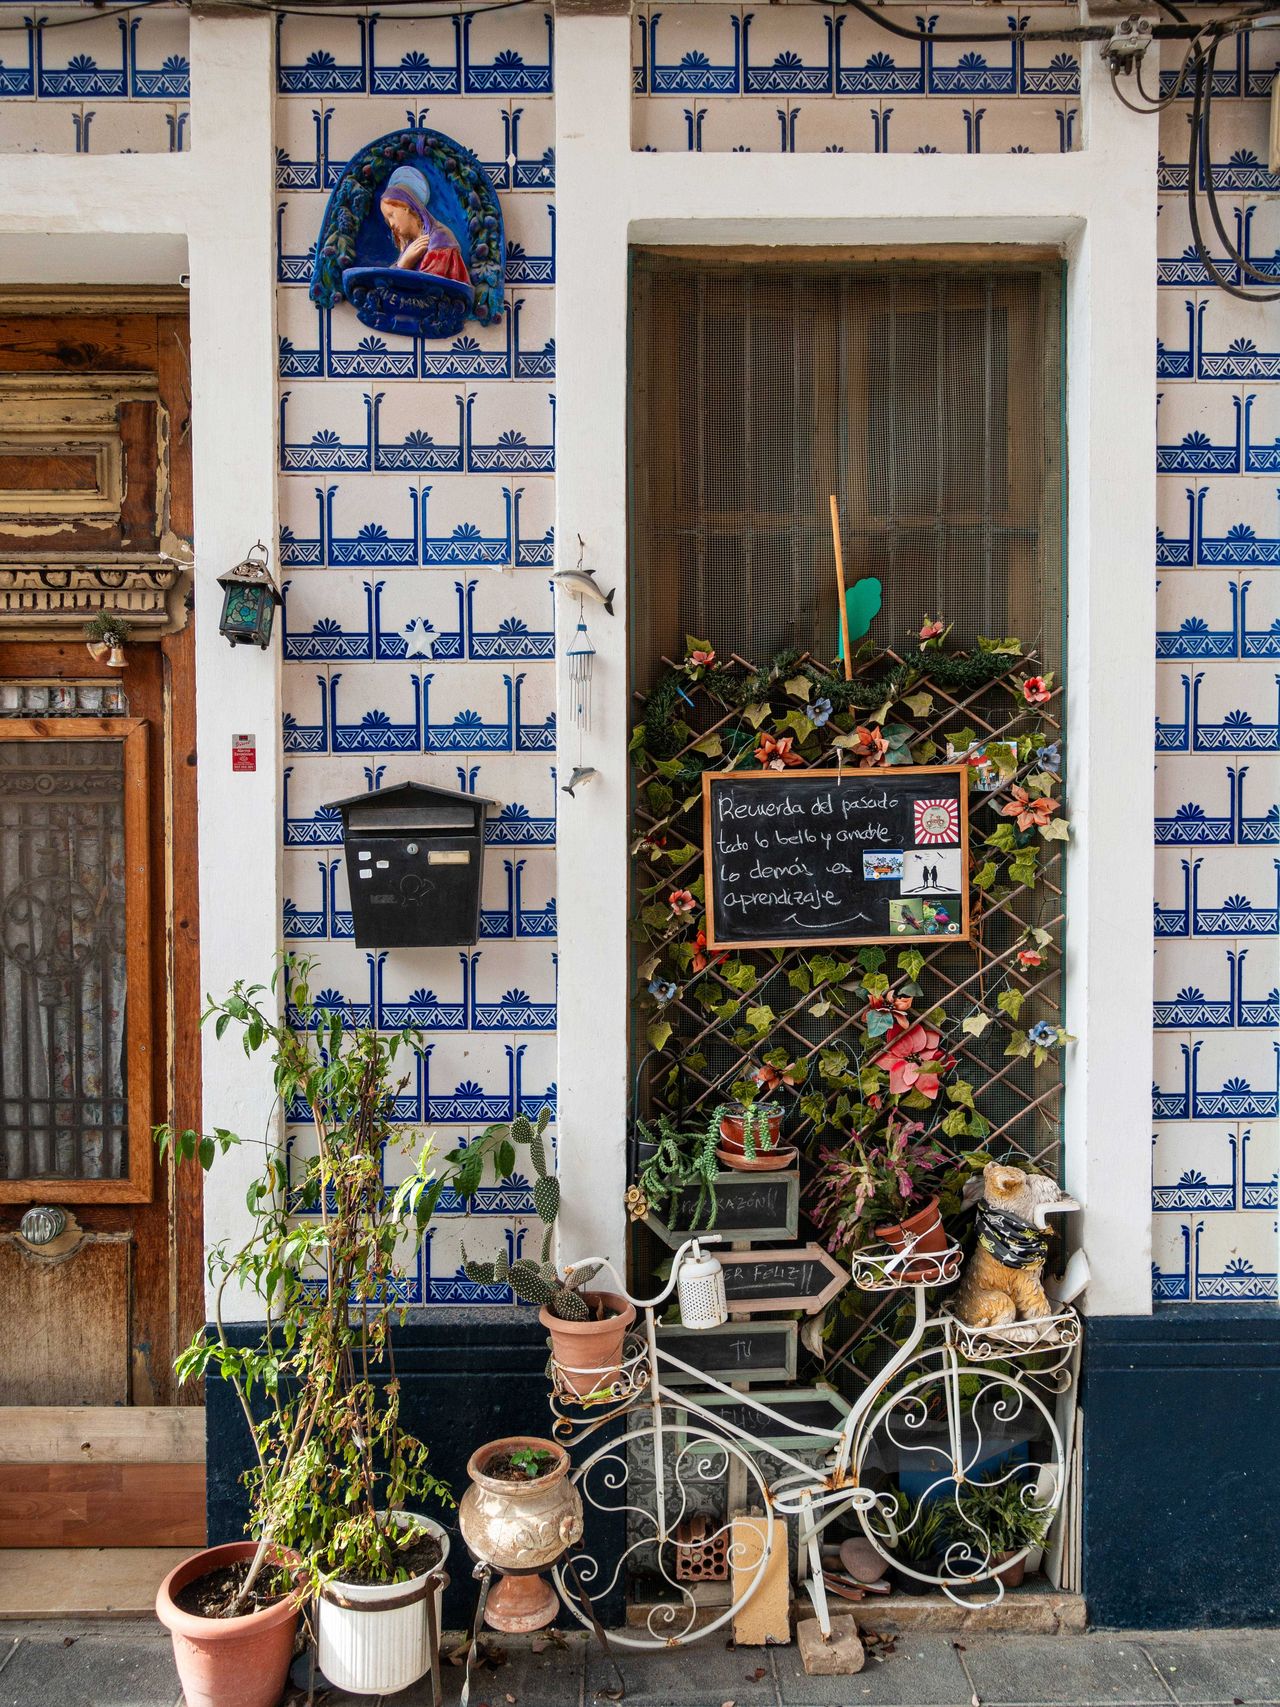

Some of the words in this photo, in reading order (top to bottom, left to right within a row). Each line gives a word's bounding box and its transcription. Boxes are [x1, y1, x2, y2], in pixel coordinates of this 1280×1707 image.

[719, 790, 805, 821] Recuerda
[811, 794, 832, 815] del
[842, 792, 898, 819] pasado
[717, 829, 749, 853] todo
[775, 829, 816, 845] bello
[821, 832, 832, 850] y
[723, 884, 841, 914] aprendizaje
